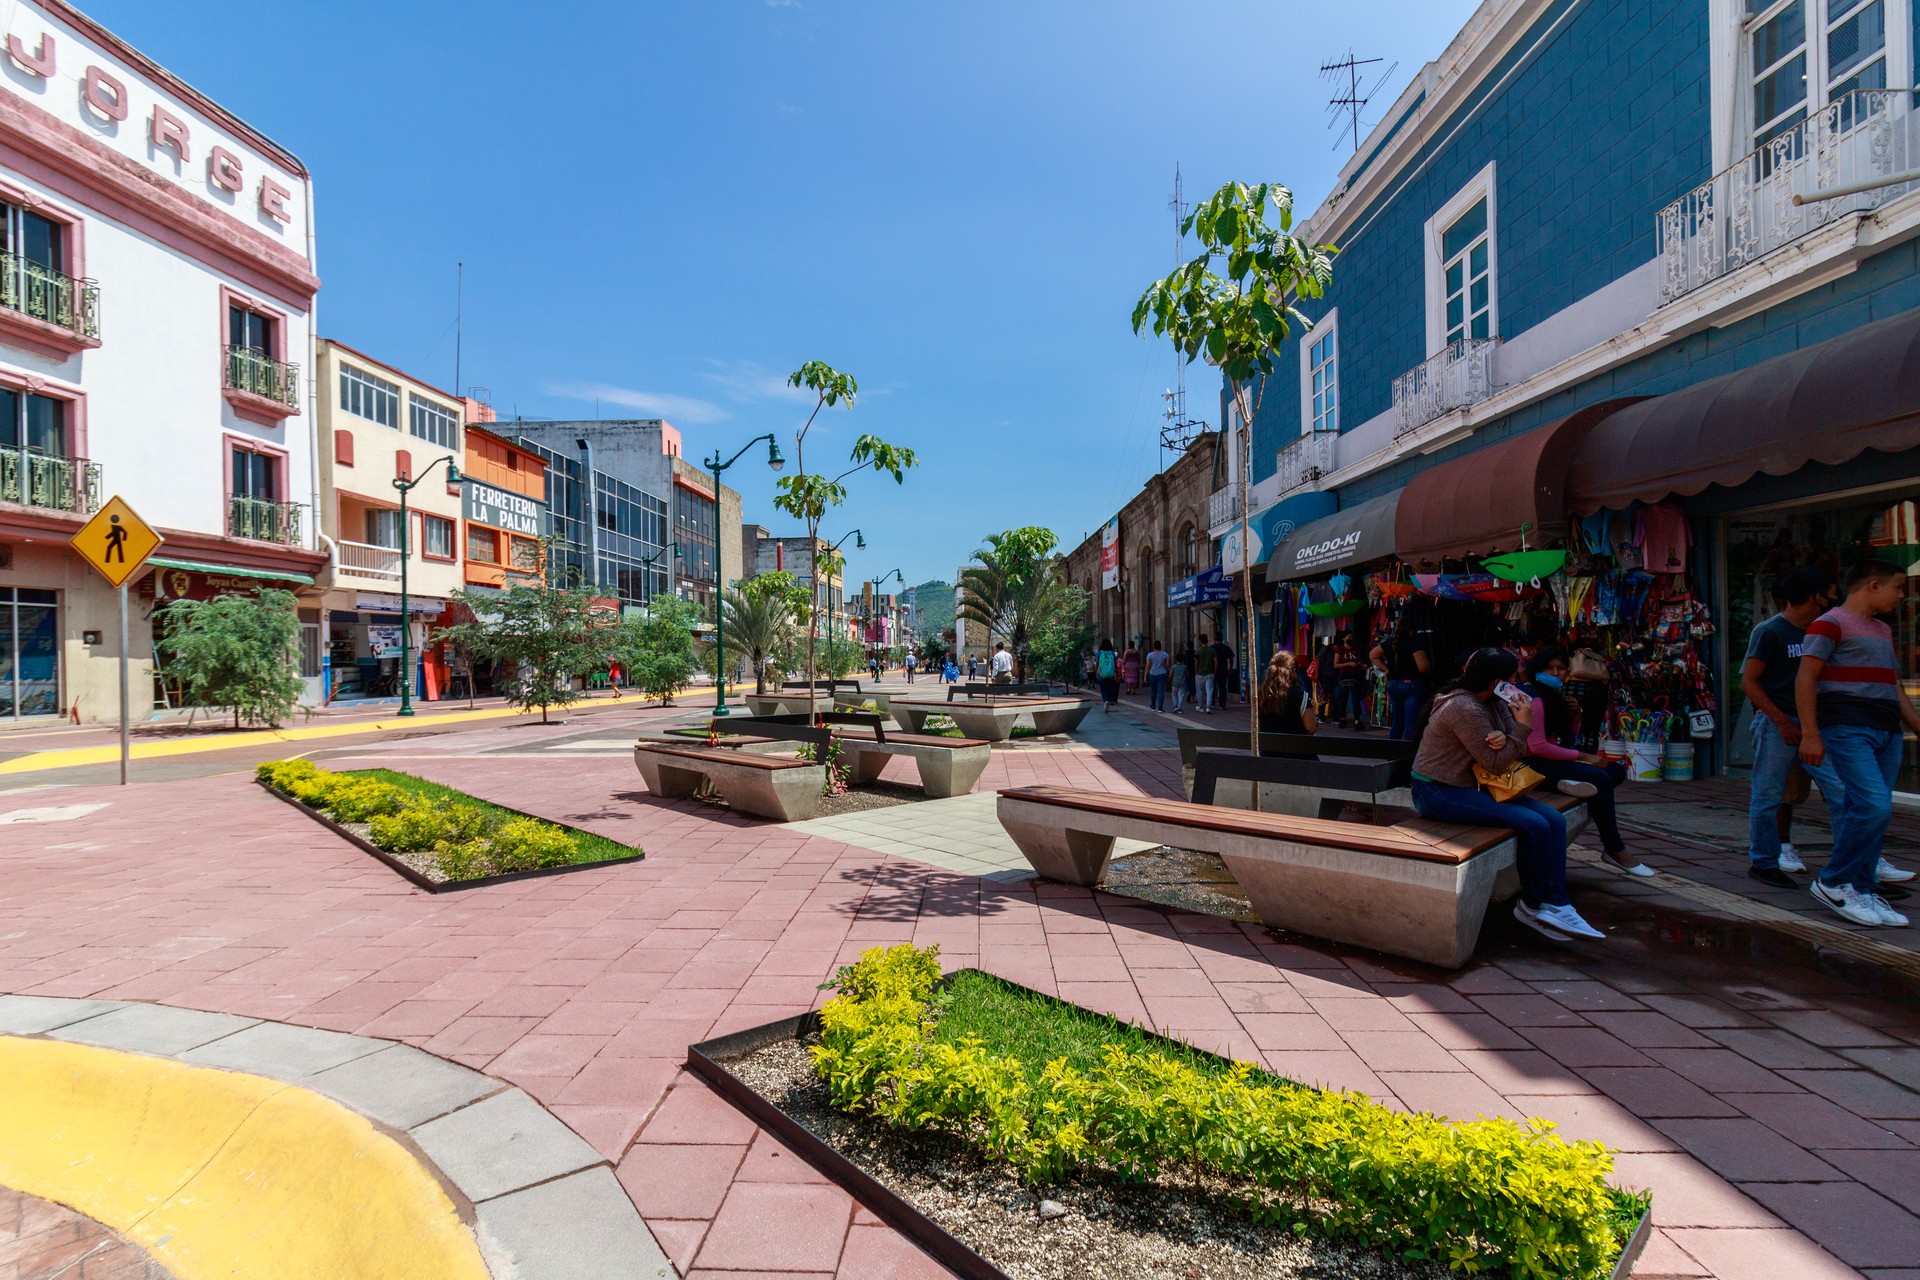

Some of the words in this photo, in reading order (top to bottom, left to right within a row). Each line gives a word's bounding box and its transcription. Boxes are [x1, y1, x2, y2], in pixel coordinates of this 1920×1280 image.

[7, 31, 291, 224] JORGE
[472, 483, 538, 518] FERRETERIA
[472, 502, 488, 523] LA
[499, 510, 538, 535] PALMA
[1296, 530, 1361, 560] OKI-DO-KI
[205, 575, 231, 588] Joyas
